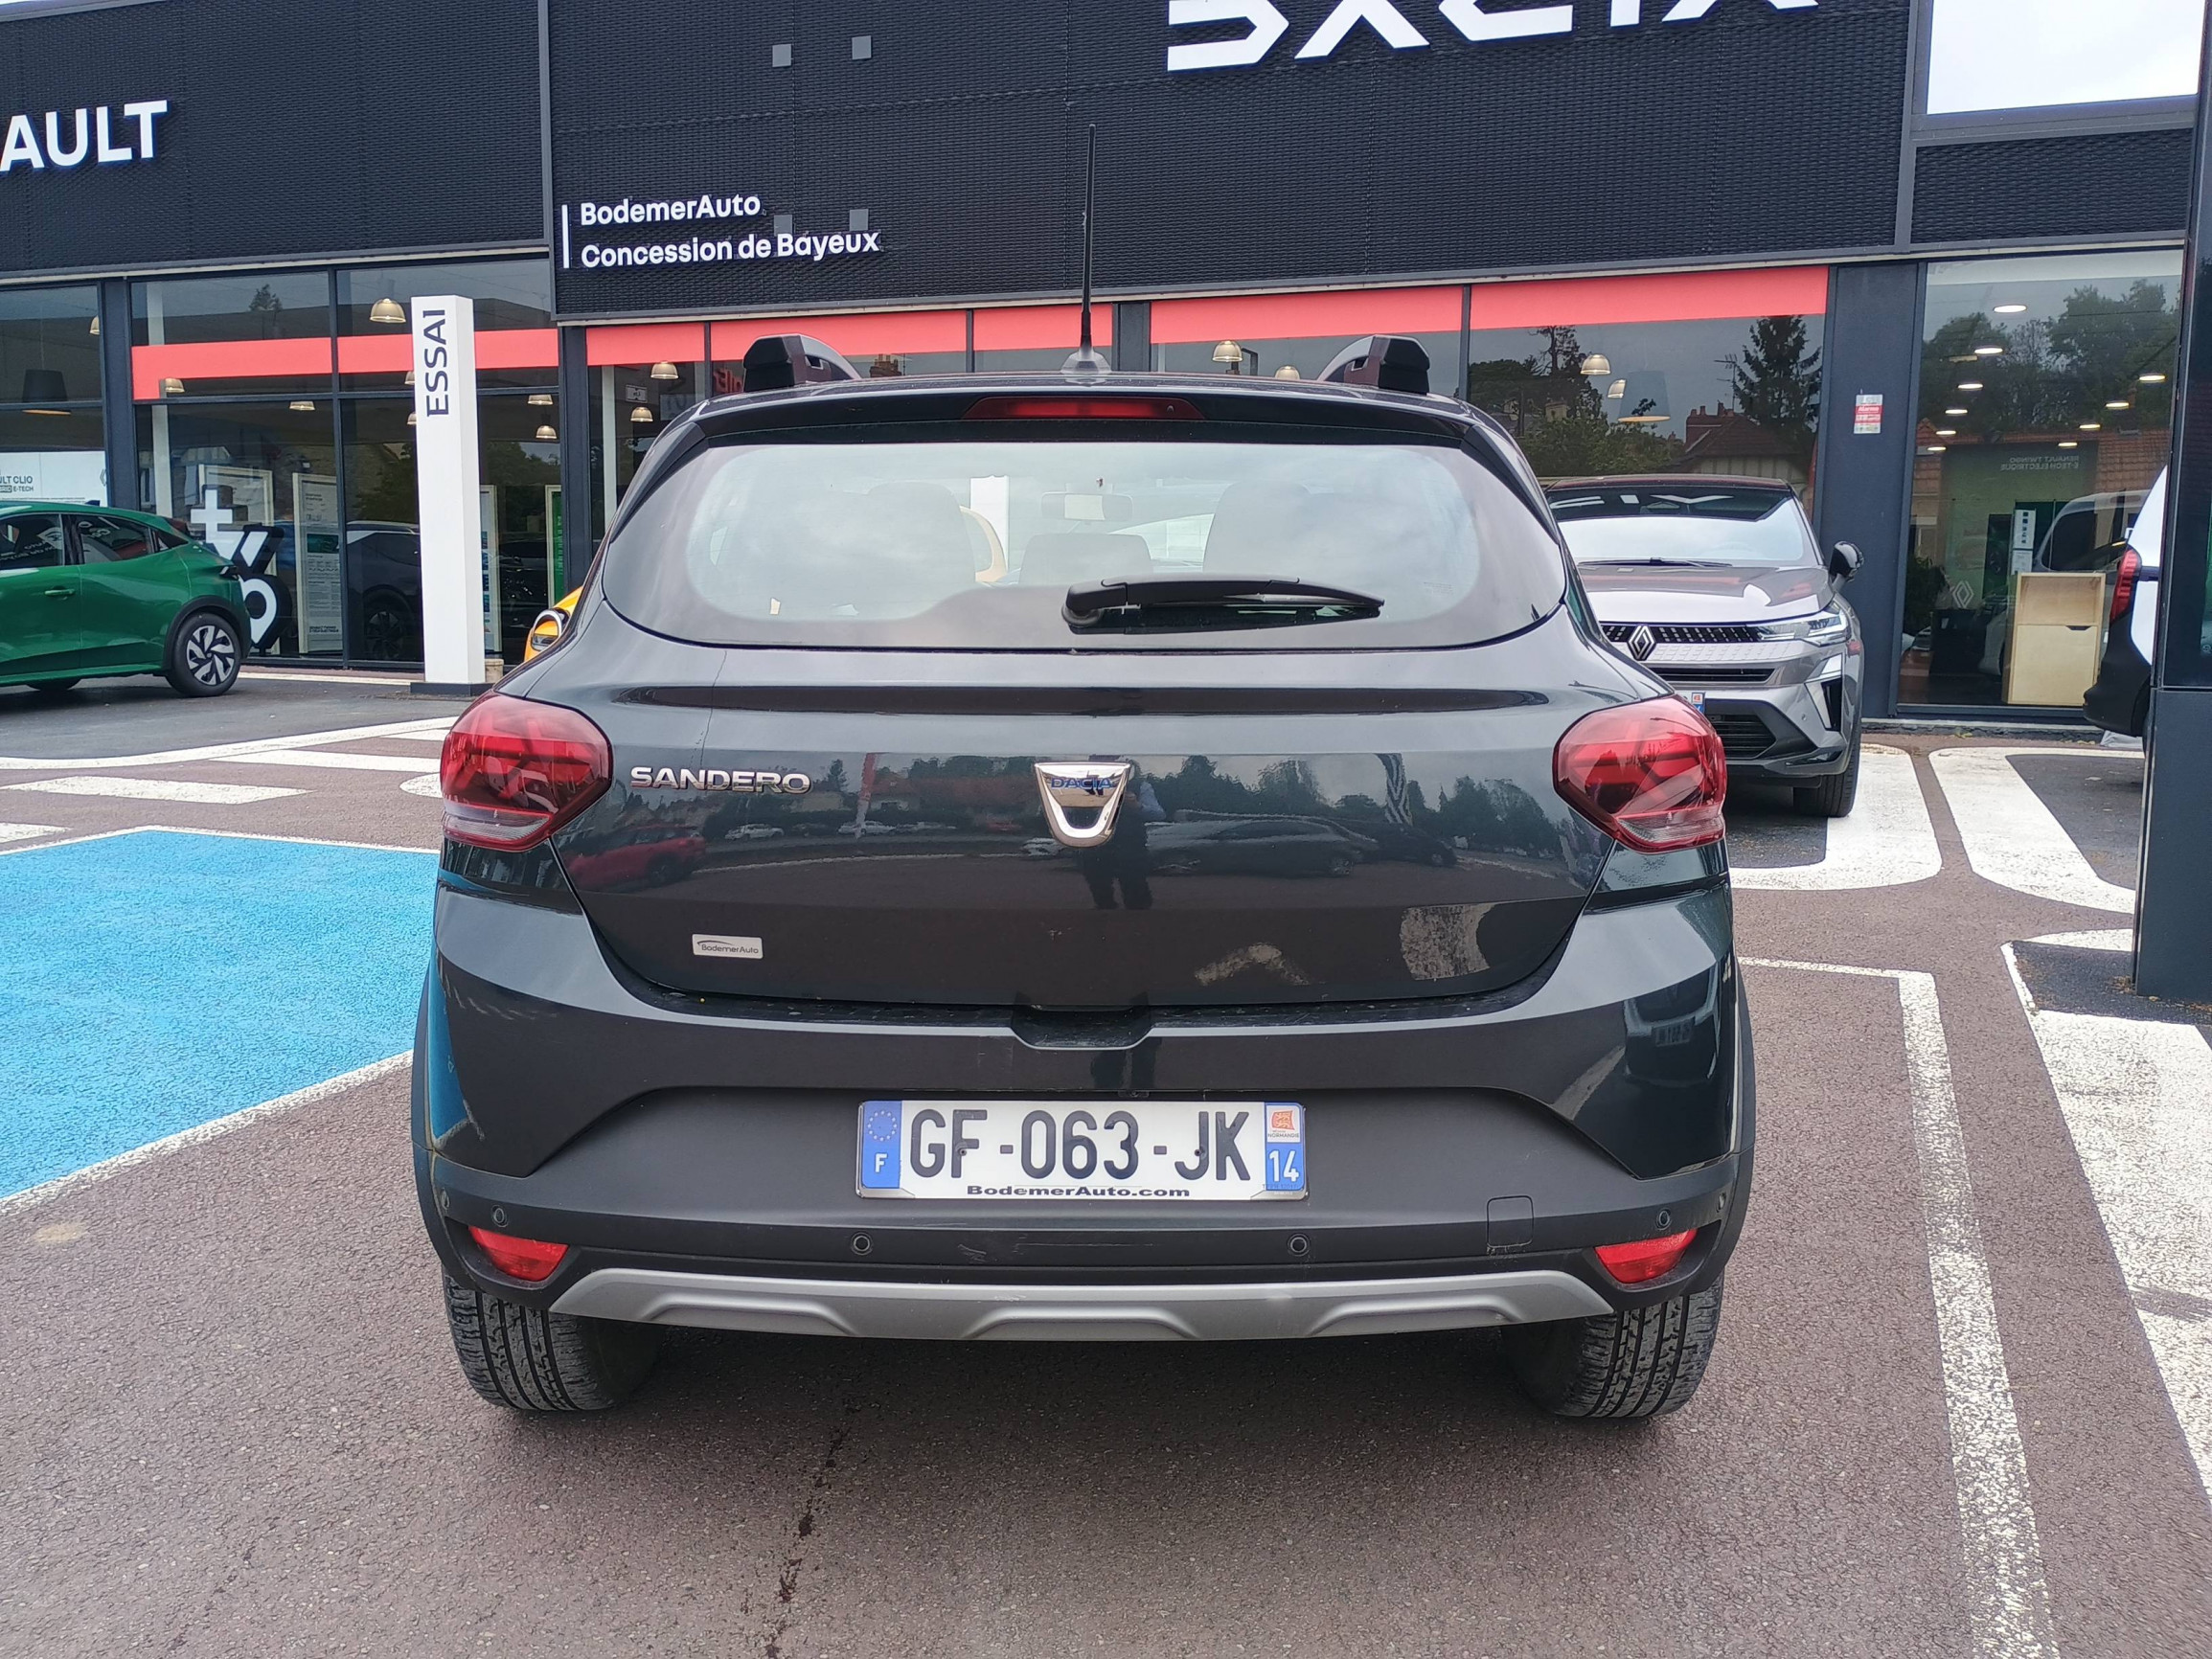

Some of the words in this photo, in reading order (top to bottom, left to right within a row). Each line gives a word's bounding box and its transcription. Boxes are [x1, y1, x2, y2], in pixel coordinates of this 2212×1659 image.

[0, 100, 168, 172] AULT
[581, 194, 761, 226] BodemerAuto
[581, 238, 733, 268] Concession
[738, 235, 771, 259] de
[777, 232, 880, 261] Bayeux
[422, 309, 449, 418] ESSAI
[12, 475, 34, 485] CLIO
[630, 766, 812, 794] SANDERO
[1051, 777, 1114, 788] DACIA
[701, 943, 759, 954] BodemerAuto
[874, 1152, 887, 1173] F
[910, 1108, 1252, 1181] GF-063-JK
[1268, 1149, 1300, 1182] 14
[966, 1185, 1191, 1198] BodemerAuto.com
